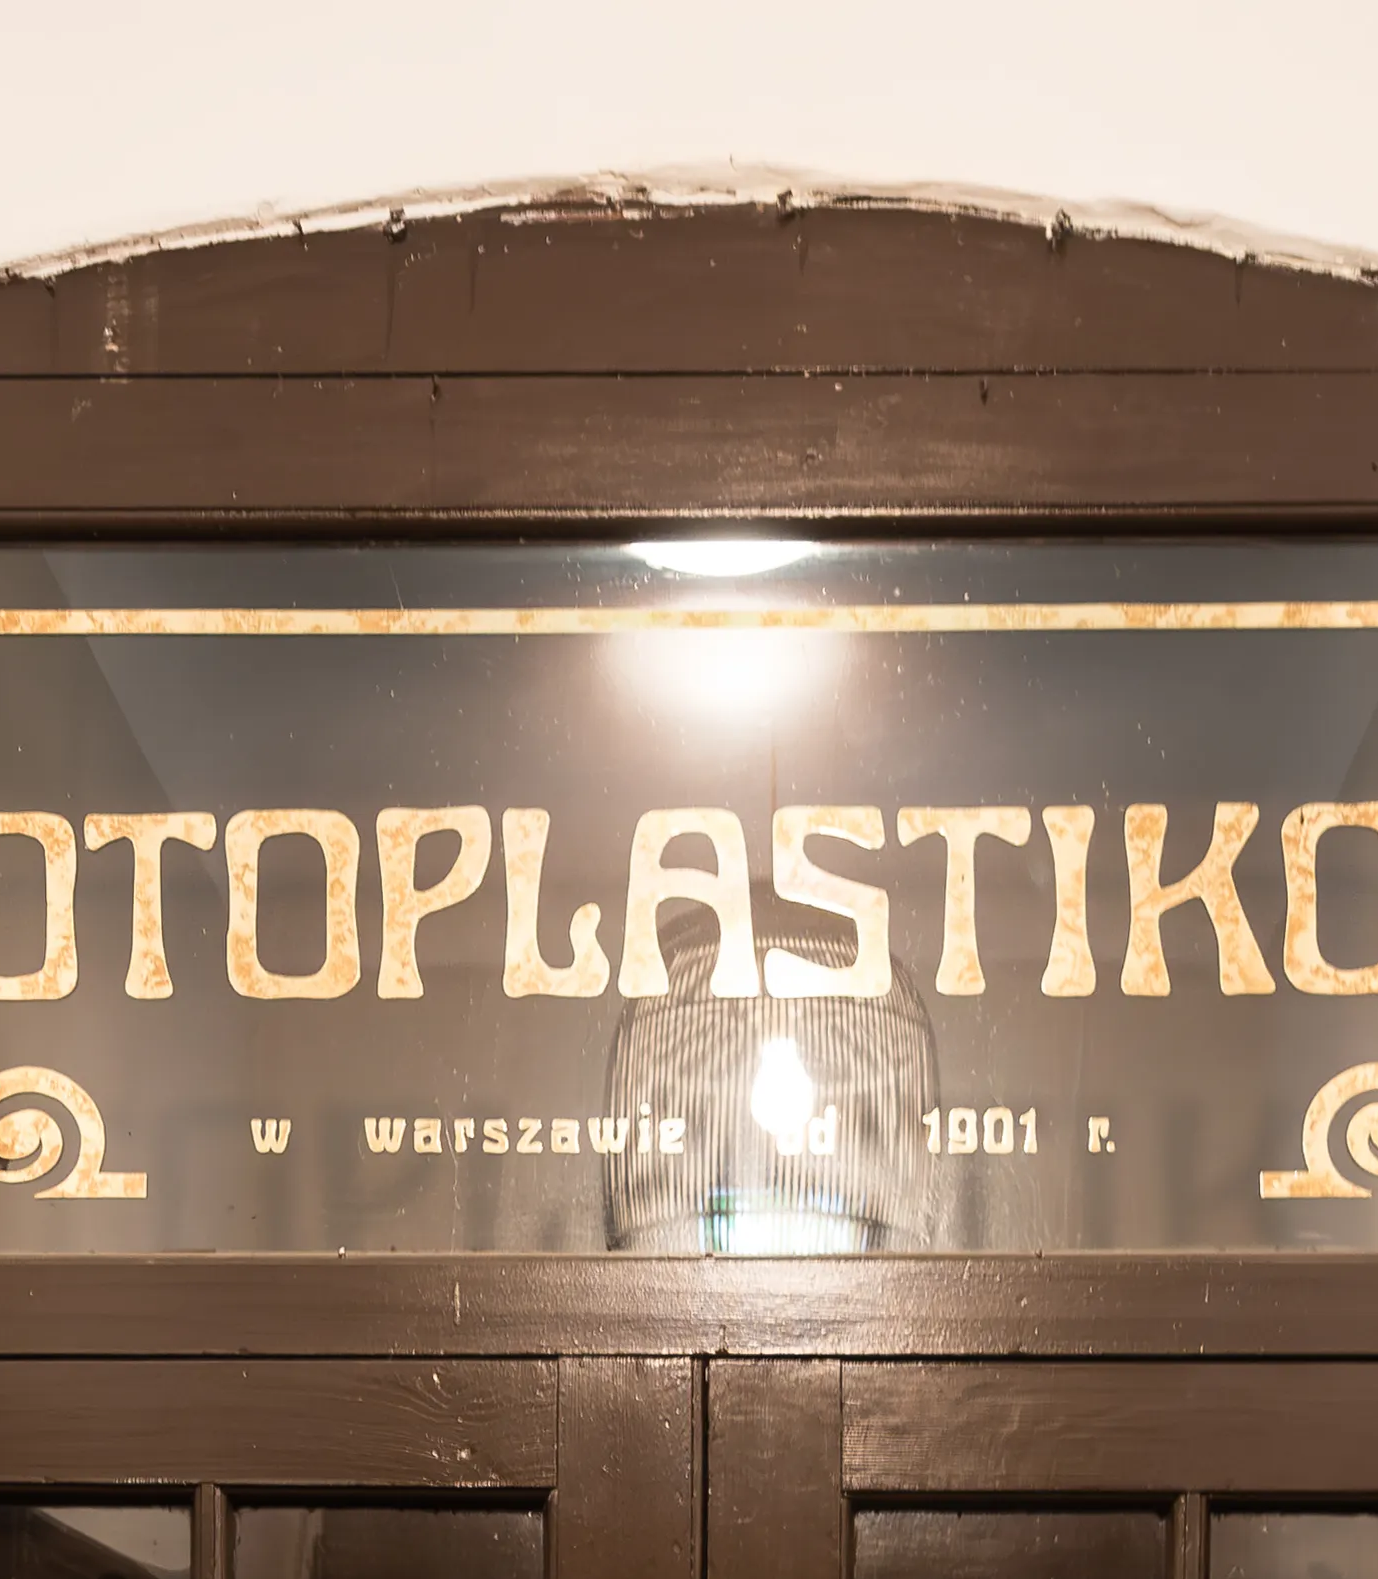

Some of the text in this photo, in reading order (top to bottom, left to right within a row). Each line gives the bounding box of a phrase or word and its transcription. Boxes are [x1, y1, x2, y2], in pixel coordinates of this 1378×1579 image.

[250, 1117, 292, 1154] w
[364, 1102, 687, 1155] warszawie
[921, 1105, 1038, 1155] 1901
[1087, 1115, 1117, 1154] r.
